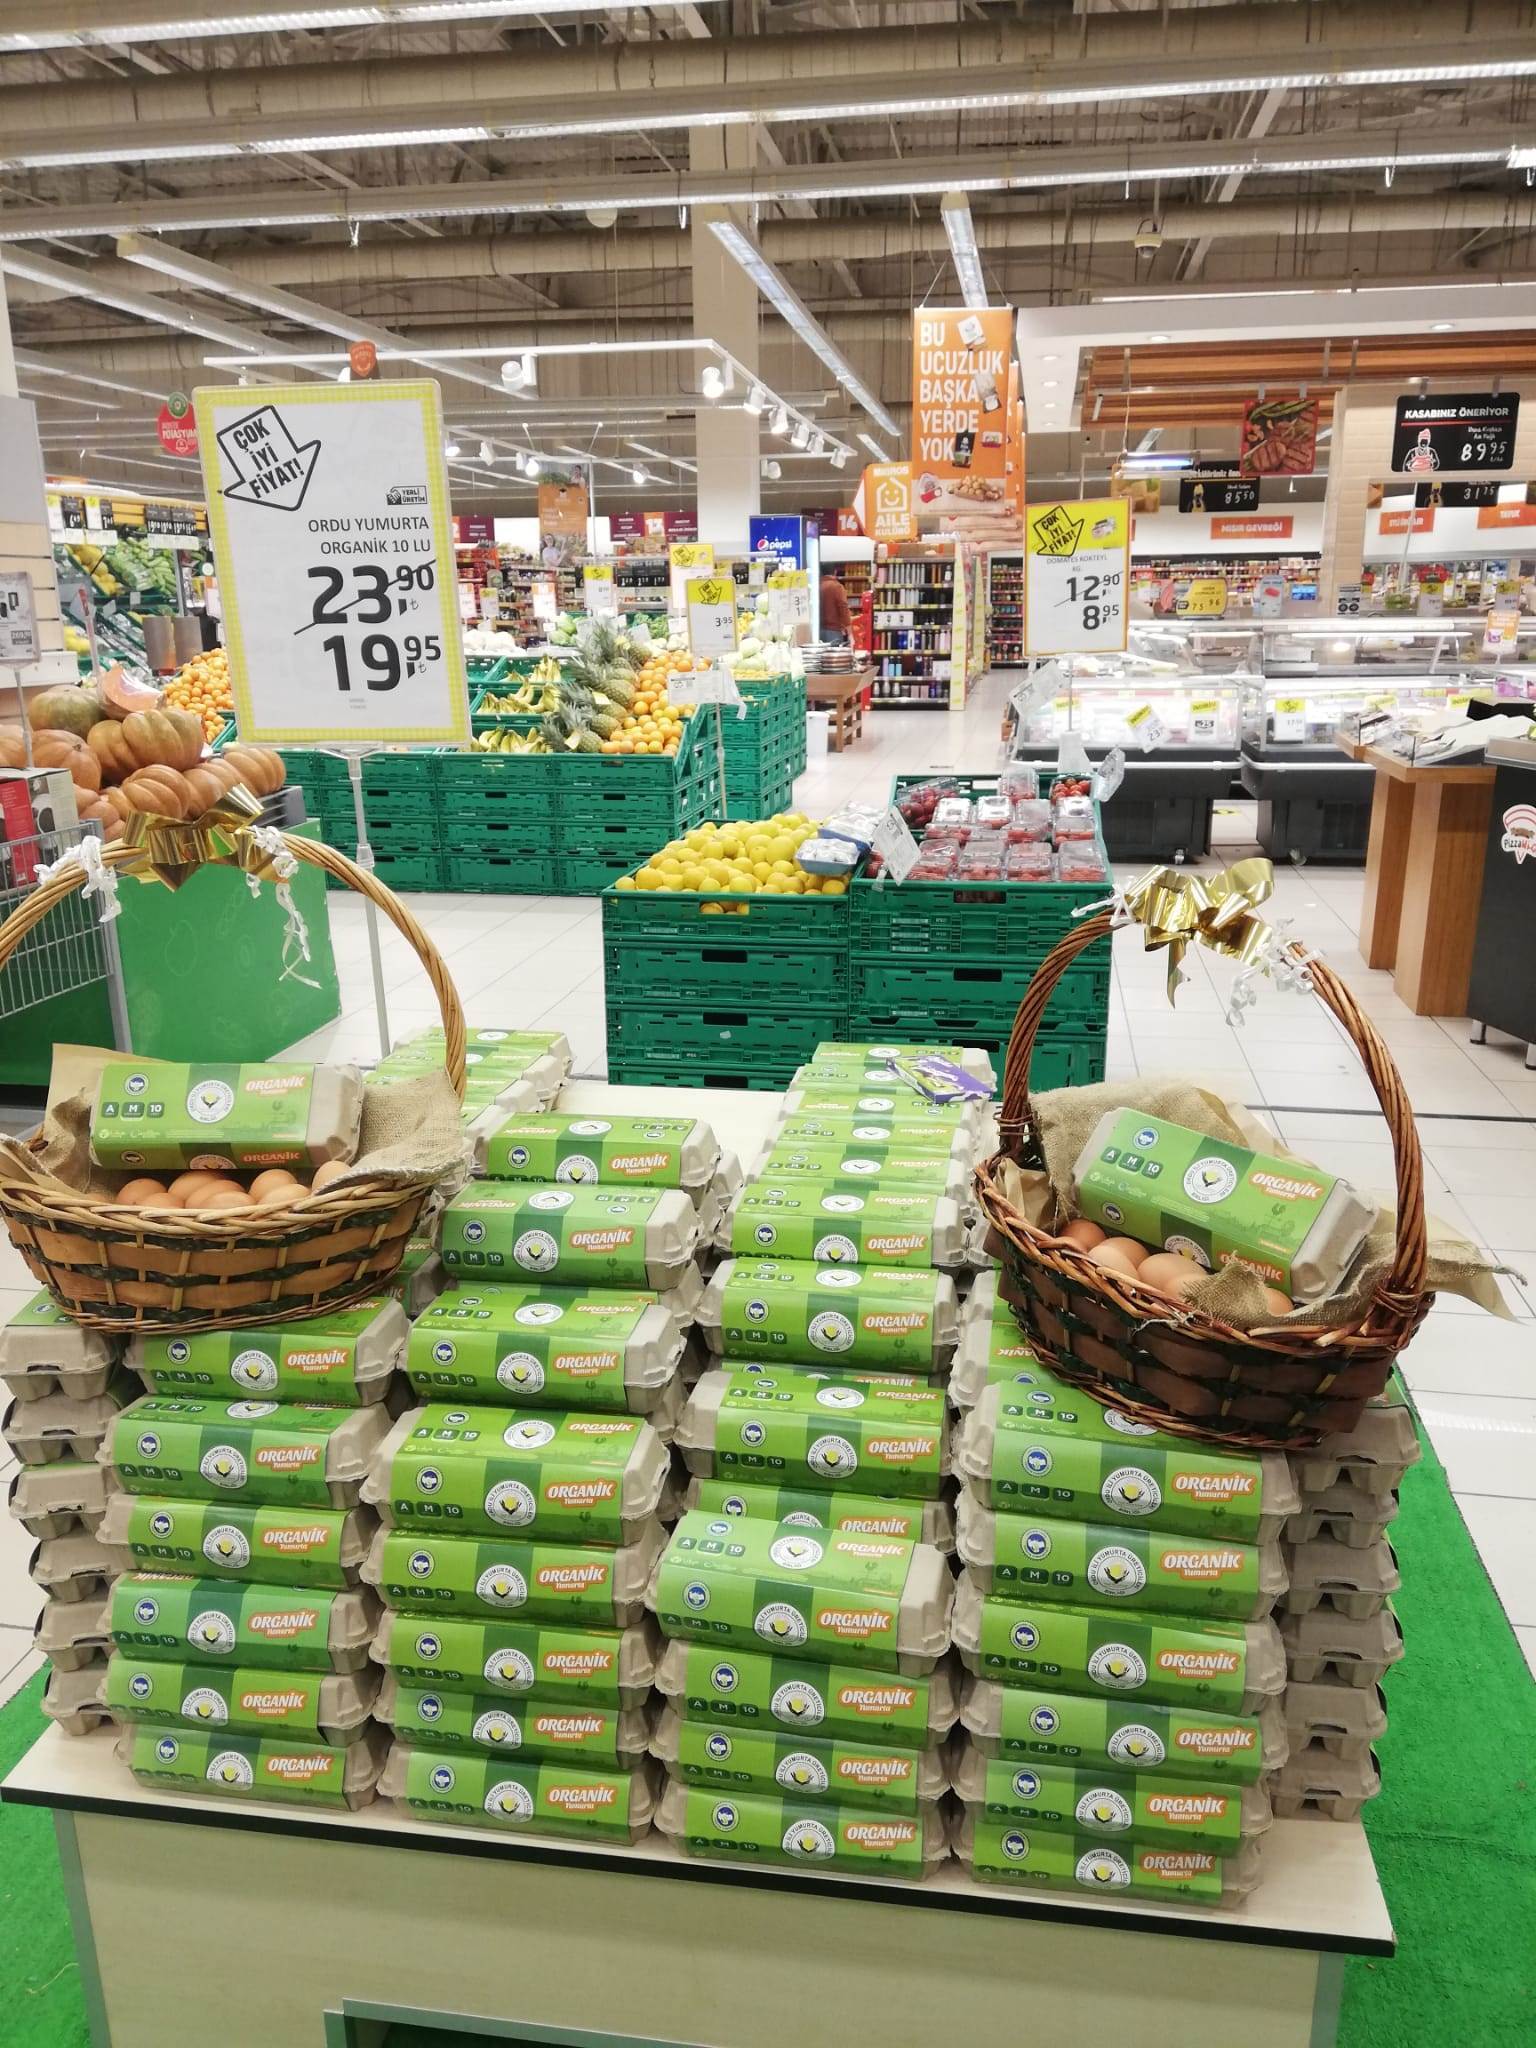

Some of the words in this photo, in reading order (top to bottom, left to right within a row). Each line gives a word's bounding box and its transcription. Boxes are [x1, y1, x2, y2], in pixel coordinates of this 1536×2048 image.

[919, 321, 945, 346] BU
[920, 351, 1003, 374] UCUZLUK
[919, 379, 980, 408] BAŞKA
[1405, 409, 1456, 418] KASABINIZ
[1459, 407, 1509, 417] ÖNERİYOR
[920, 410, 979, 433] YERDE
[233, 418, 270, 453] ÇOK
[249, 442, 278, 471] İYİ
[920, 438, 956, 461] YOK
[249, 458, 304, 498] FİYAT!
[308, 519, 350, 532] ORDU
[354, 517, 429, 530] YUMURTA
[875, 513, 910, 527] AİLE
[1041, 513, 1060, 531] ÇOK
[321, 537, 388, 554] ORGANİK
[393, 540, 409, 552] 10
[414, 539, 431, 552] LU
[769, 540, 792, 549] pepsi
[1049, 531, 1076, 553] FİYAT!
[245, 1074, 305, 1092] ORGANİK
[106, 1104, 114, 1113] A
[128, 1104, 138, 1113] M
[150, 1104, 162, 1113] 10
[243, 1151, 301, 1163] ORGANİK
[612, 1154, 668, 1168] ORGANİK
[1107, 1151, 1115, 1159] A
[1126, 1156, 1137, 1165] M
[1147, 1163, 1159, 1173] 10
[1251, 1173, 1321, 1197] ORGANİK
[572, 1229, 632, 1244] ORGANİK
[868, 1236, 924, 1250] ORGANİK
[866, 1315, 925, 1328] ORGANİK
[730, 1330, 738, 1338] A
[772, 1333, 784, 1341] 10
[287, 1350, 346, 1365] ORGANİK
[556, 1353, 617, 1368] ORGANİK
[876, 1391, 937, 1399] ORGANİK
[1060, 1412, 1075, 1420] 10
[569, 1423, 633, 1432] ORGANİK
[868, 1440, 932, 1453] ORGANİK
[259, 1448, 317, 1462] ORGANİK
[770, 1458, 782, 1466] 10
[548, 1482, 614, 1498] ORGANİK
[1176, 1475, 1253, 1491] ORGANİK
[1030, 1486, 1041, 1494] M
[1056, 1490, 1070, 1498] 10
[1195, 1490, 1229, 1499] Yumurta
[264, 1529, 326, 1543] ORGANİK
[681, 1539, 692, 1547] A
[707, 1541, 716, 1550] M
[729, 1545, 742, 1554] 10
[837, 1542, 904, 1555] ORGANİK
[1098, 1550, 1126, 1560] YUMURTA
[1164, 1552, 1240, 1569] ORGANİK
[539, 1567, 605, 1583] ORGANİK
[1184, 1568, 1218, 1577] Yumurta
[251, 1612, 315, 1628] ORGANİK
[820, 1611, 890, 1628] ORGANİK
[546, 1654, 610, 1668] ORGANİK
[1160, 1653, 1236, 1669] ORGANİK
[1179, 1667, 1213, 1676] Yumurta
[242, 1693, 304, 1708] ORGANİK
[841, 1689, 912, 1705] ORGANİK
[538, 1718, 602, 1732] ORGANİK
[1179, 1729, 1254, 1746] ORGANİK
[268, 1756, 329, 1771] ORGANİK
[840, 1761, 909, 1776] ORGANİK
[549, 1788, 615, 1803] ORGANİK
[1150, 1797, 1225, 1813] ORGANİK
[847, 1824, 913, 1839] ORGANİK
[1143, 1855, 1213, 1869] ORGANİK
